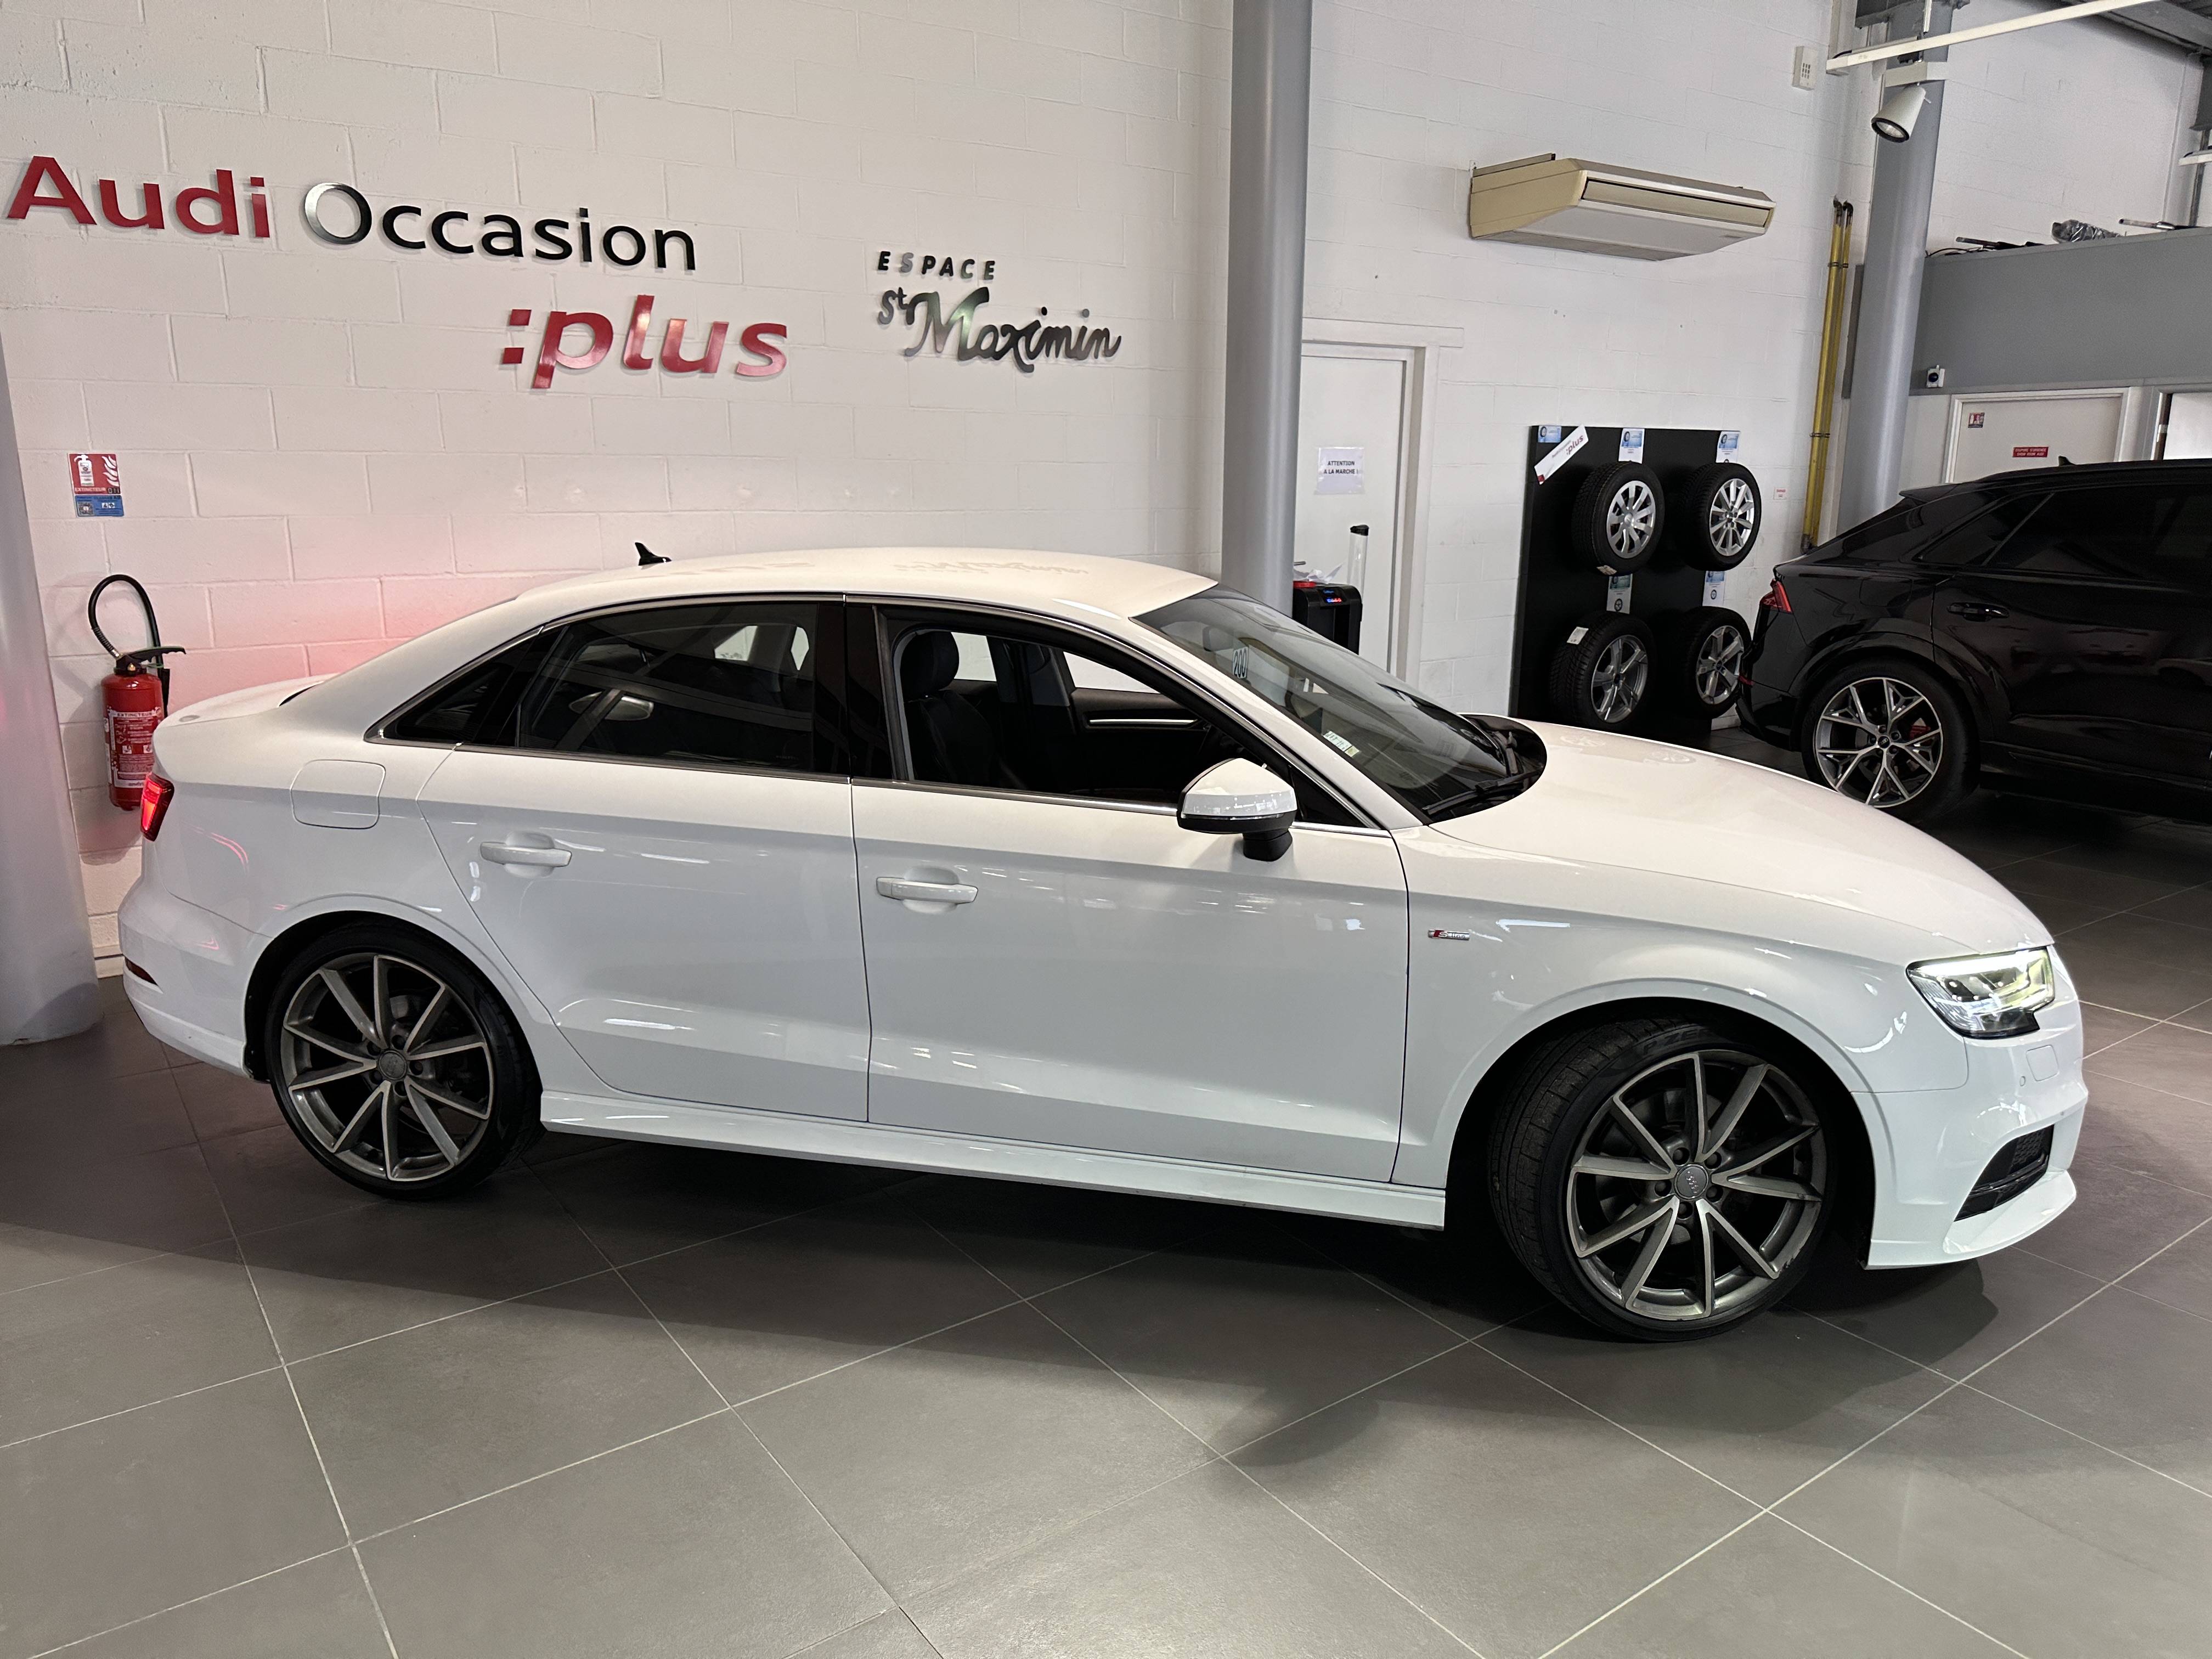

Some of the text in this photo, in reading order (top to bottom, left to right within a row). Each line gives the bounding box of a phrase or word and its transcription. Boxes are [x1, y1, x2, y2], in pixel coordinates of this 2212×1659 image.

[8, 156, 696, 270] Audi Occasion
[878, 251, 995, 280] ESPACE
[905, 286, 1121, 373] Maximin
